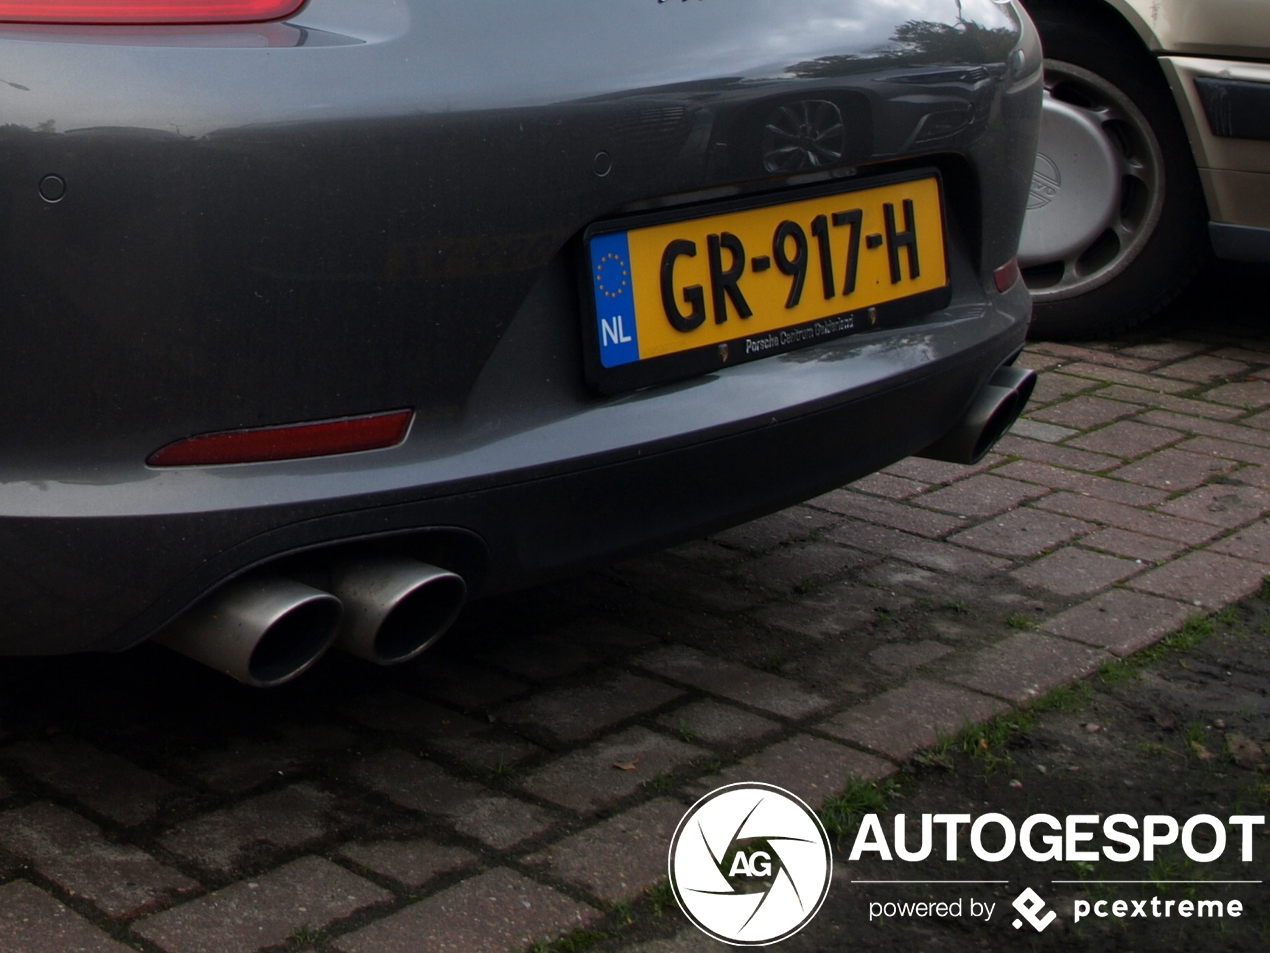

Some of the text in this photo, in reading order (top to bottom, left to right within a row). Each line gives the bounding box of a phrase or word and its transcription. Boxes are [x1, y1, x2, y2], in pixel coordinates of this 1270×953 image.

[660, 198, 920, 334] GR-917-H
[600, 314, 632, 347] NL
[745, 333, 779, 354] Porsche
[779, 327, 814, 345] Centrum
